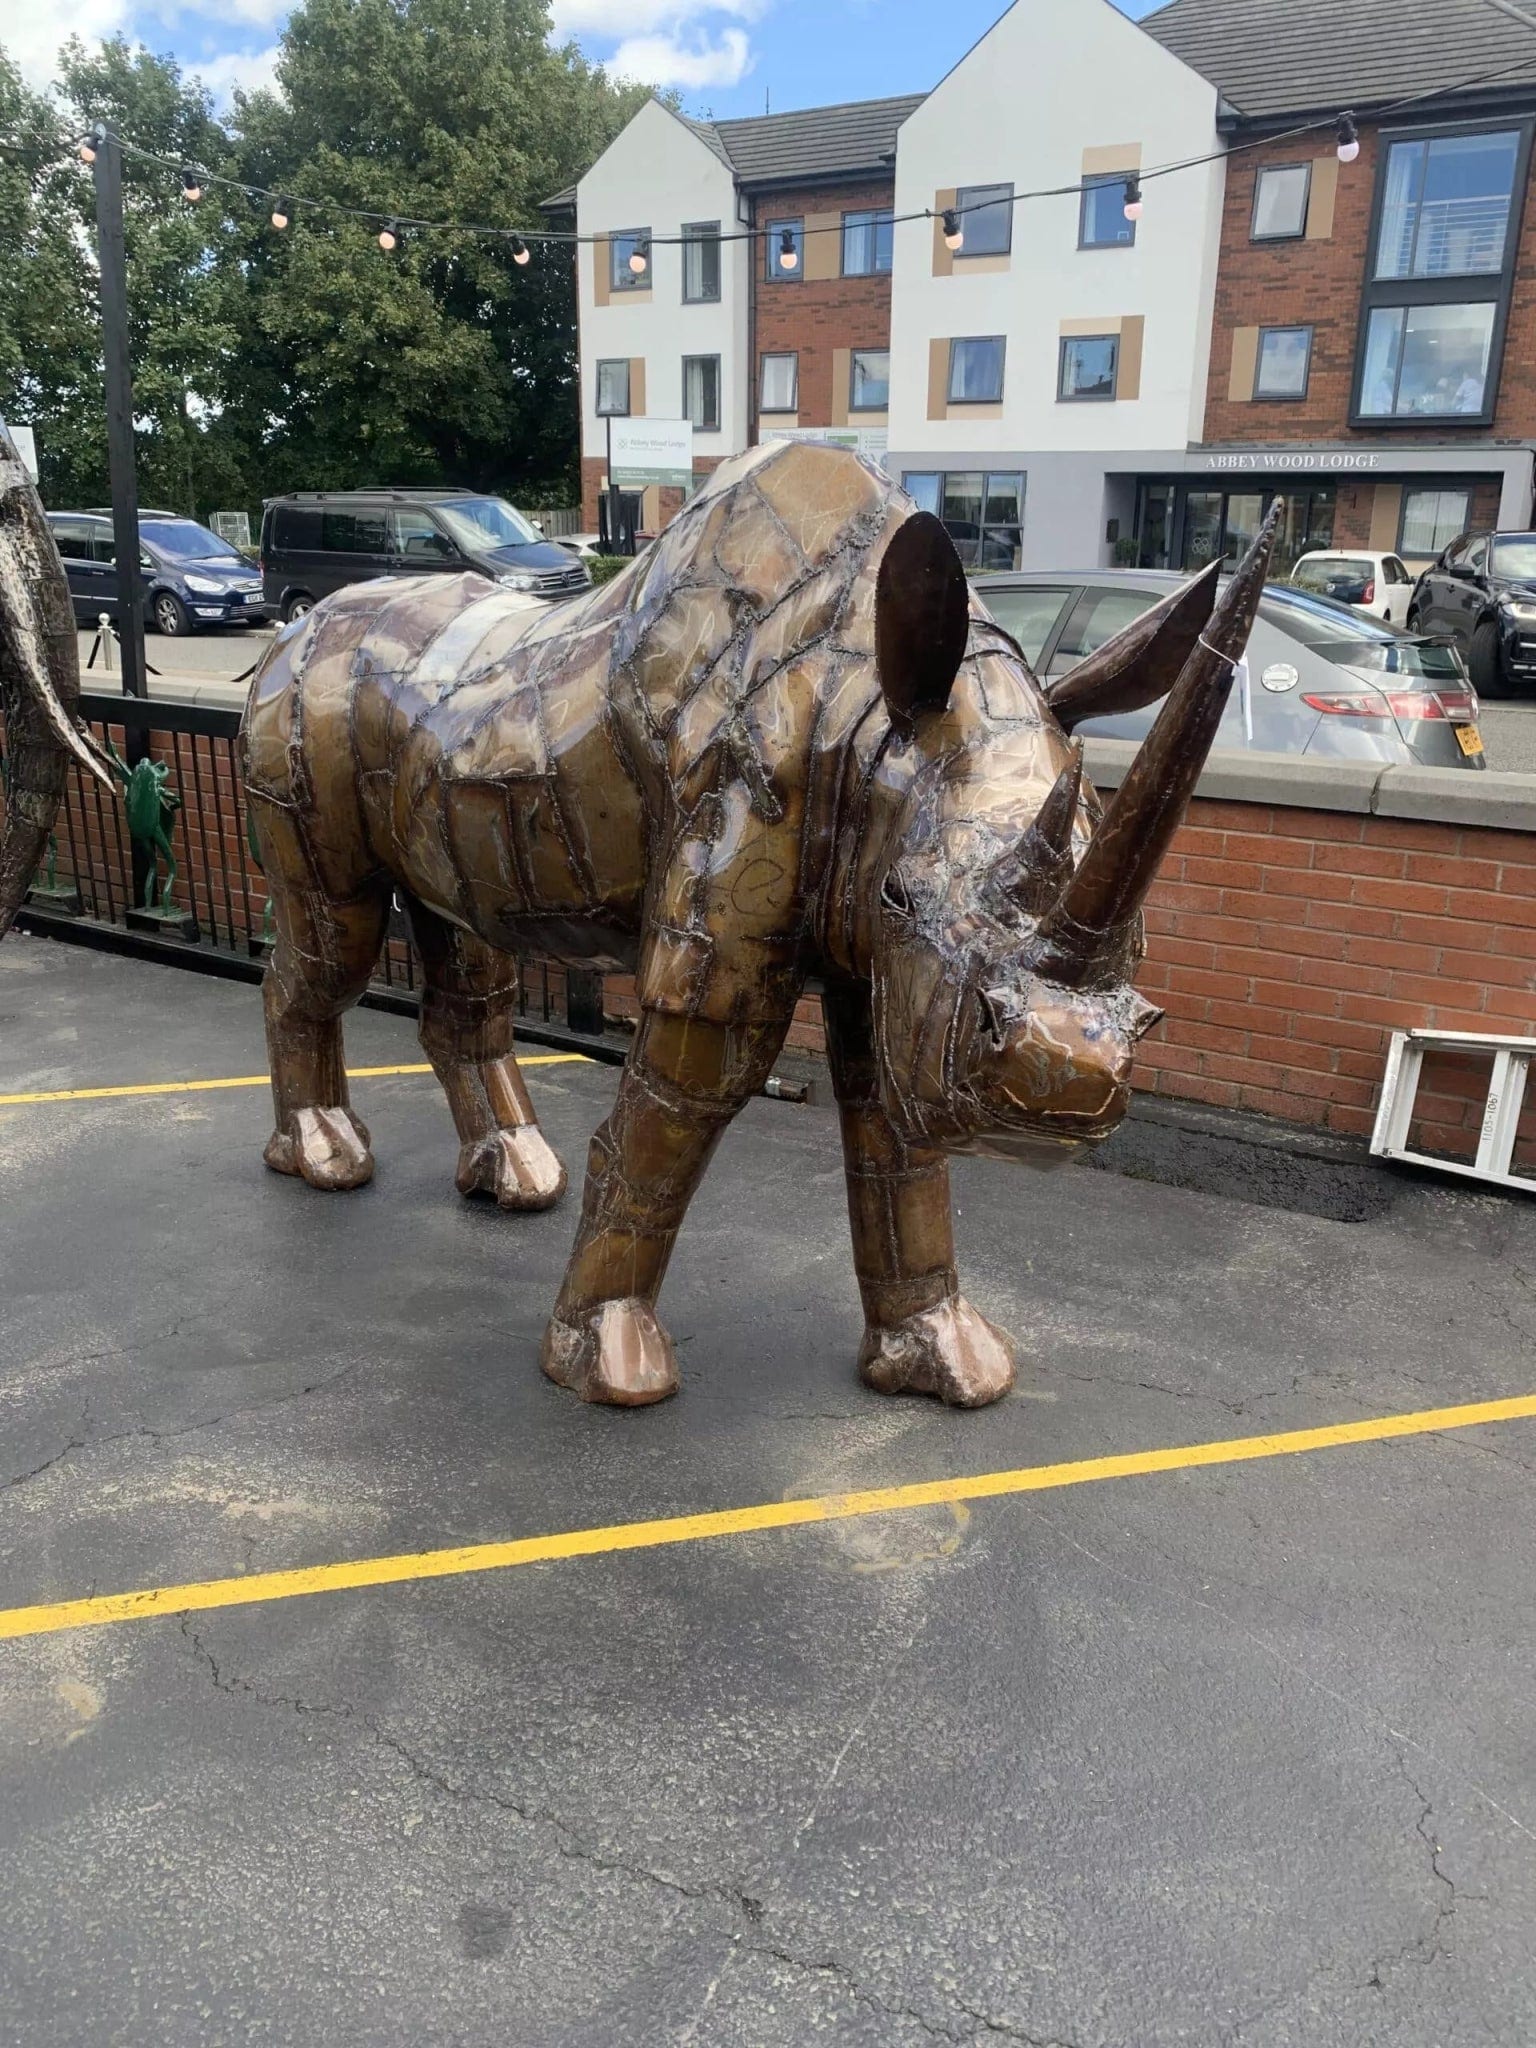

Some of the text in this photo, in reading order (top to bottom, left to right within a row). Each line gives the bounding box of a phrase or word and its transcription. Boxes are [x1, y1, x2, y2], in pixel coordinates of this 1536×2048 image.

[1206, 454, 1380, 468] ABBEY WOOD LODGE
